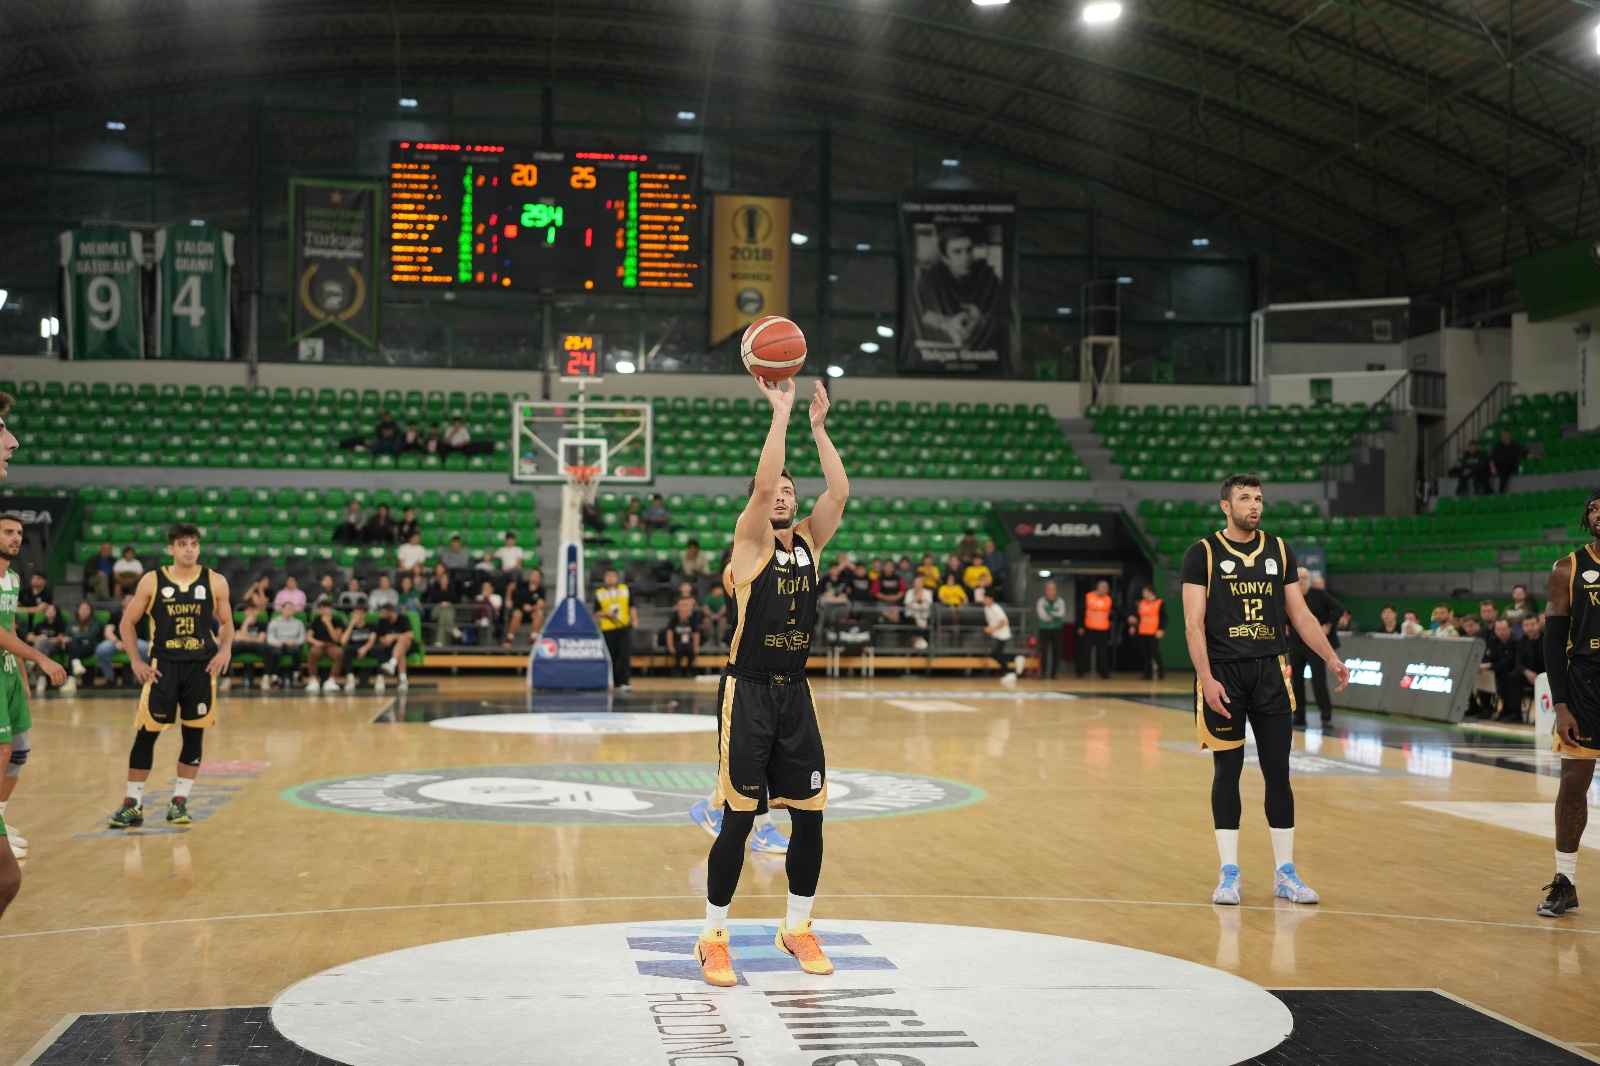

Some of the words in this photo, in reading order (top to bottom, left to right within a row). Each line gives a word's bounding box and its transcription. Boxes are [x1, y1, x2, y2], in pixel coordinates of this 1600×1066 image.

[511, 163, 538, 187] 20
[730, 246, 773, 262] 2018
[87, 275, 122, 332] 9
[172, 274, 206, 328] 4
[567, 351, 597, 375] 24
[1034, 523, 1101, 537] LASSA
[1229, 581, 1273, 596] KONYA
[166, 604, 202, 616] KONYA
[1242, 598, 1264, 621] 12
